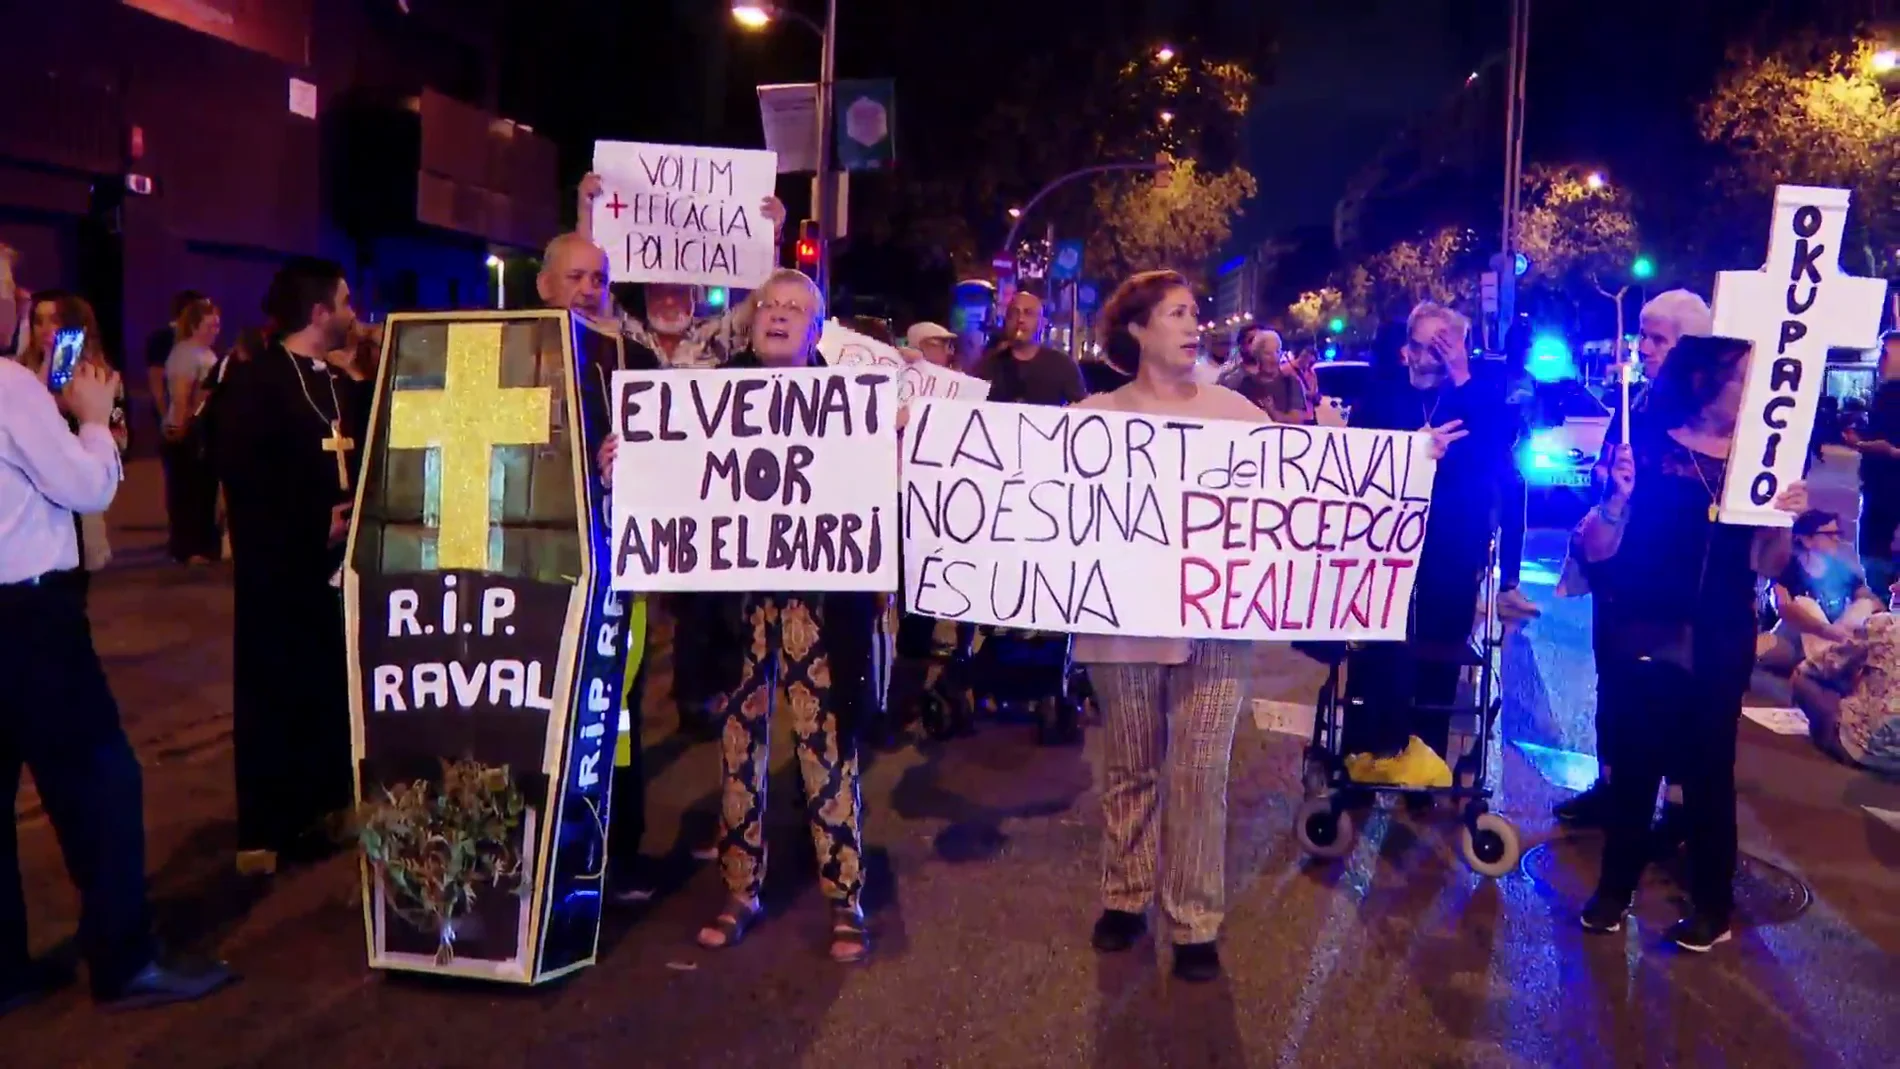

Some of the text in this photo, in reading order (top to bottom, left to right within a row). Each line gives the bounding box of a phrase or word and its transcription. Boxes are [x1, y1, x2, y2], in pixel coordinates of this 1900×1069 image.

[621, 381, 688, 442] EL
[700, 444, 814, 506] MOR
[911, 404, 1004, 471] LA
[1018, 412, 1204, 481] MORT
[1249, 426, 1430, 502] RAVAL
[906, 471, 1170, 546] NO ÉS UNA
[616, 514, 698, 577] AMB
[710, 514, 759, 571] EL
[914, 547, 1120, 628] ÉS UNA
[374, 659, 554, 712] RAVAL
